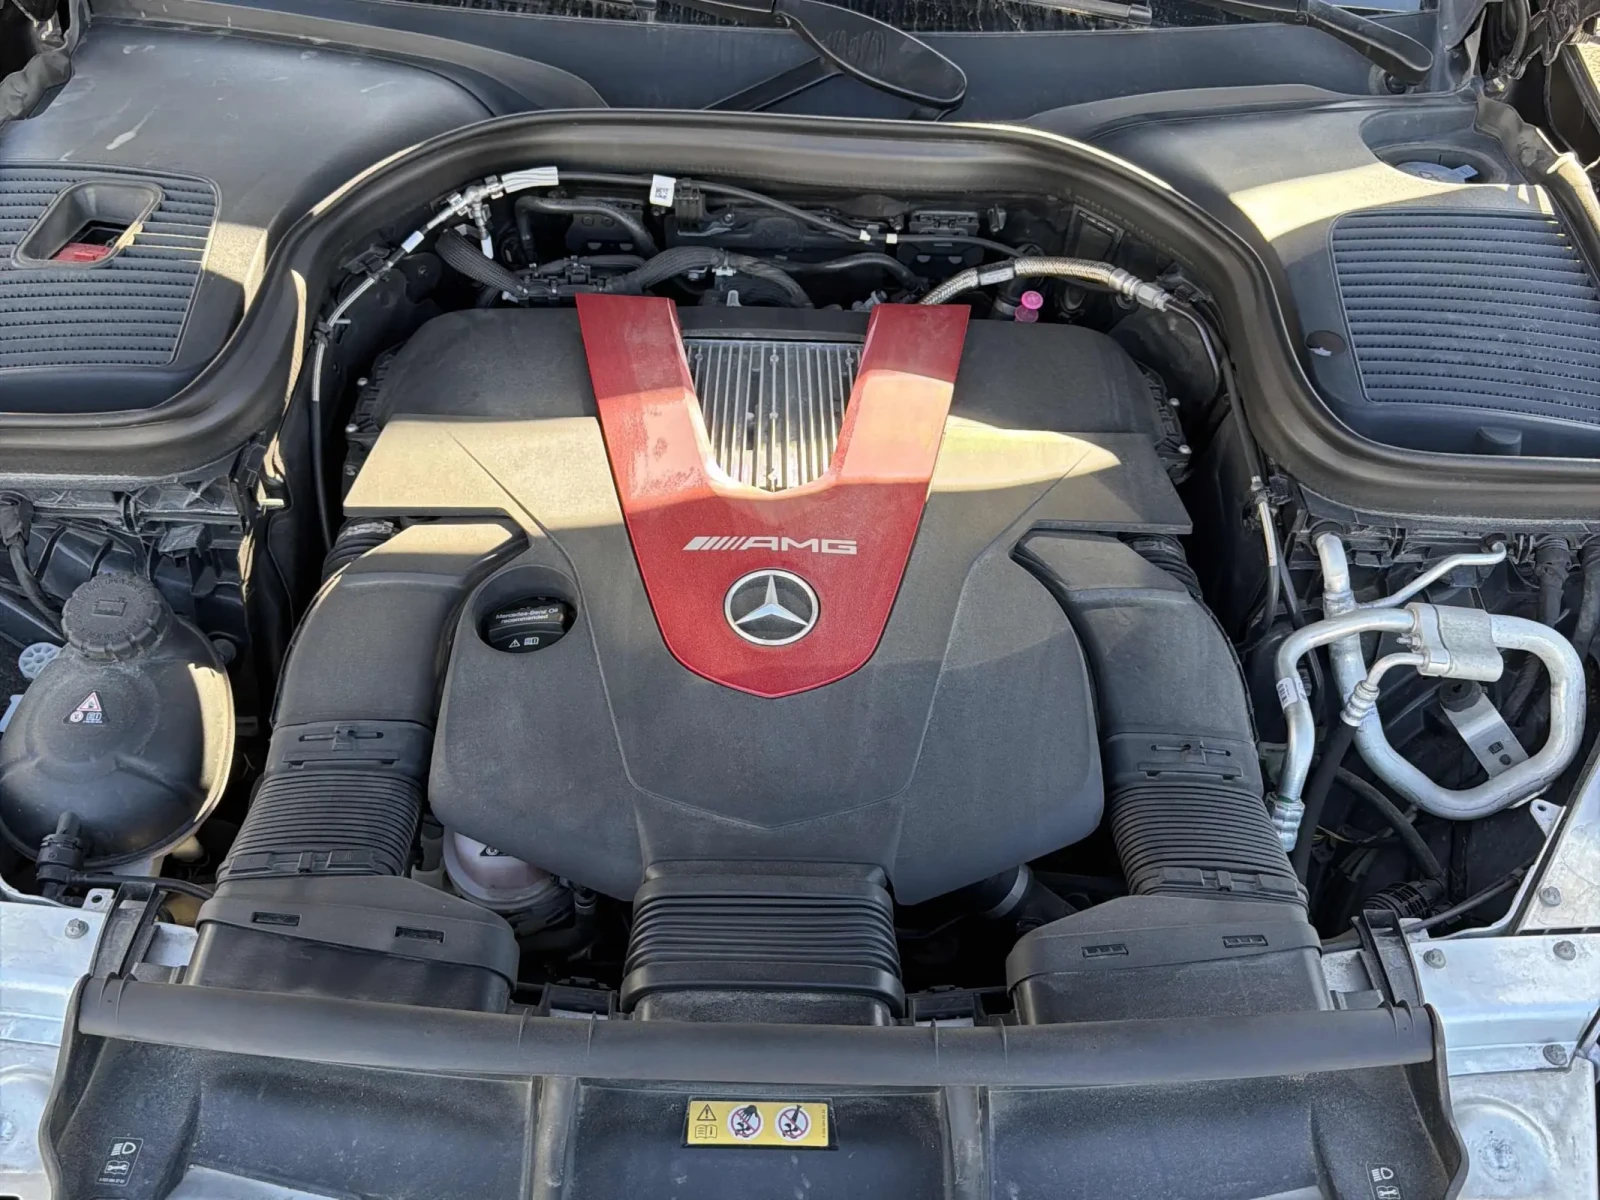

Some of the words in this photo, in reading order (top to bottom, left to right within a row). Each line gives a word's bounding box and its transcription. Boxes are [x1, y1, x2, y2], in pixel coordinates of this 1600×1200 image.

[739, 536, 858, 555] AMG
[495, 609, 548, 620] Mercedes-Benz
[501, 613, 549, 624] recommended
